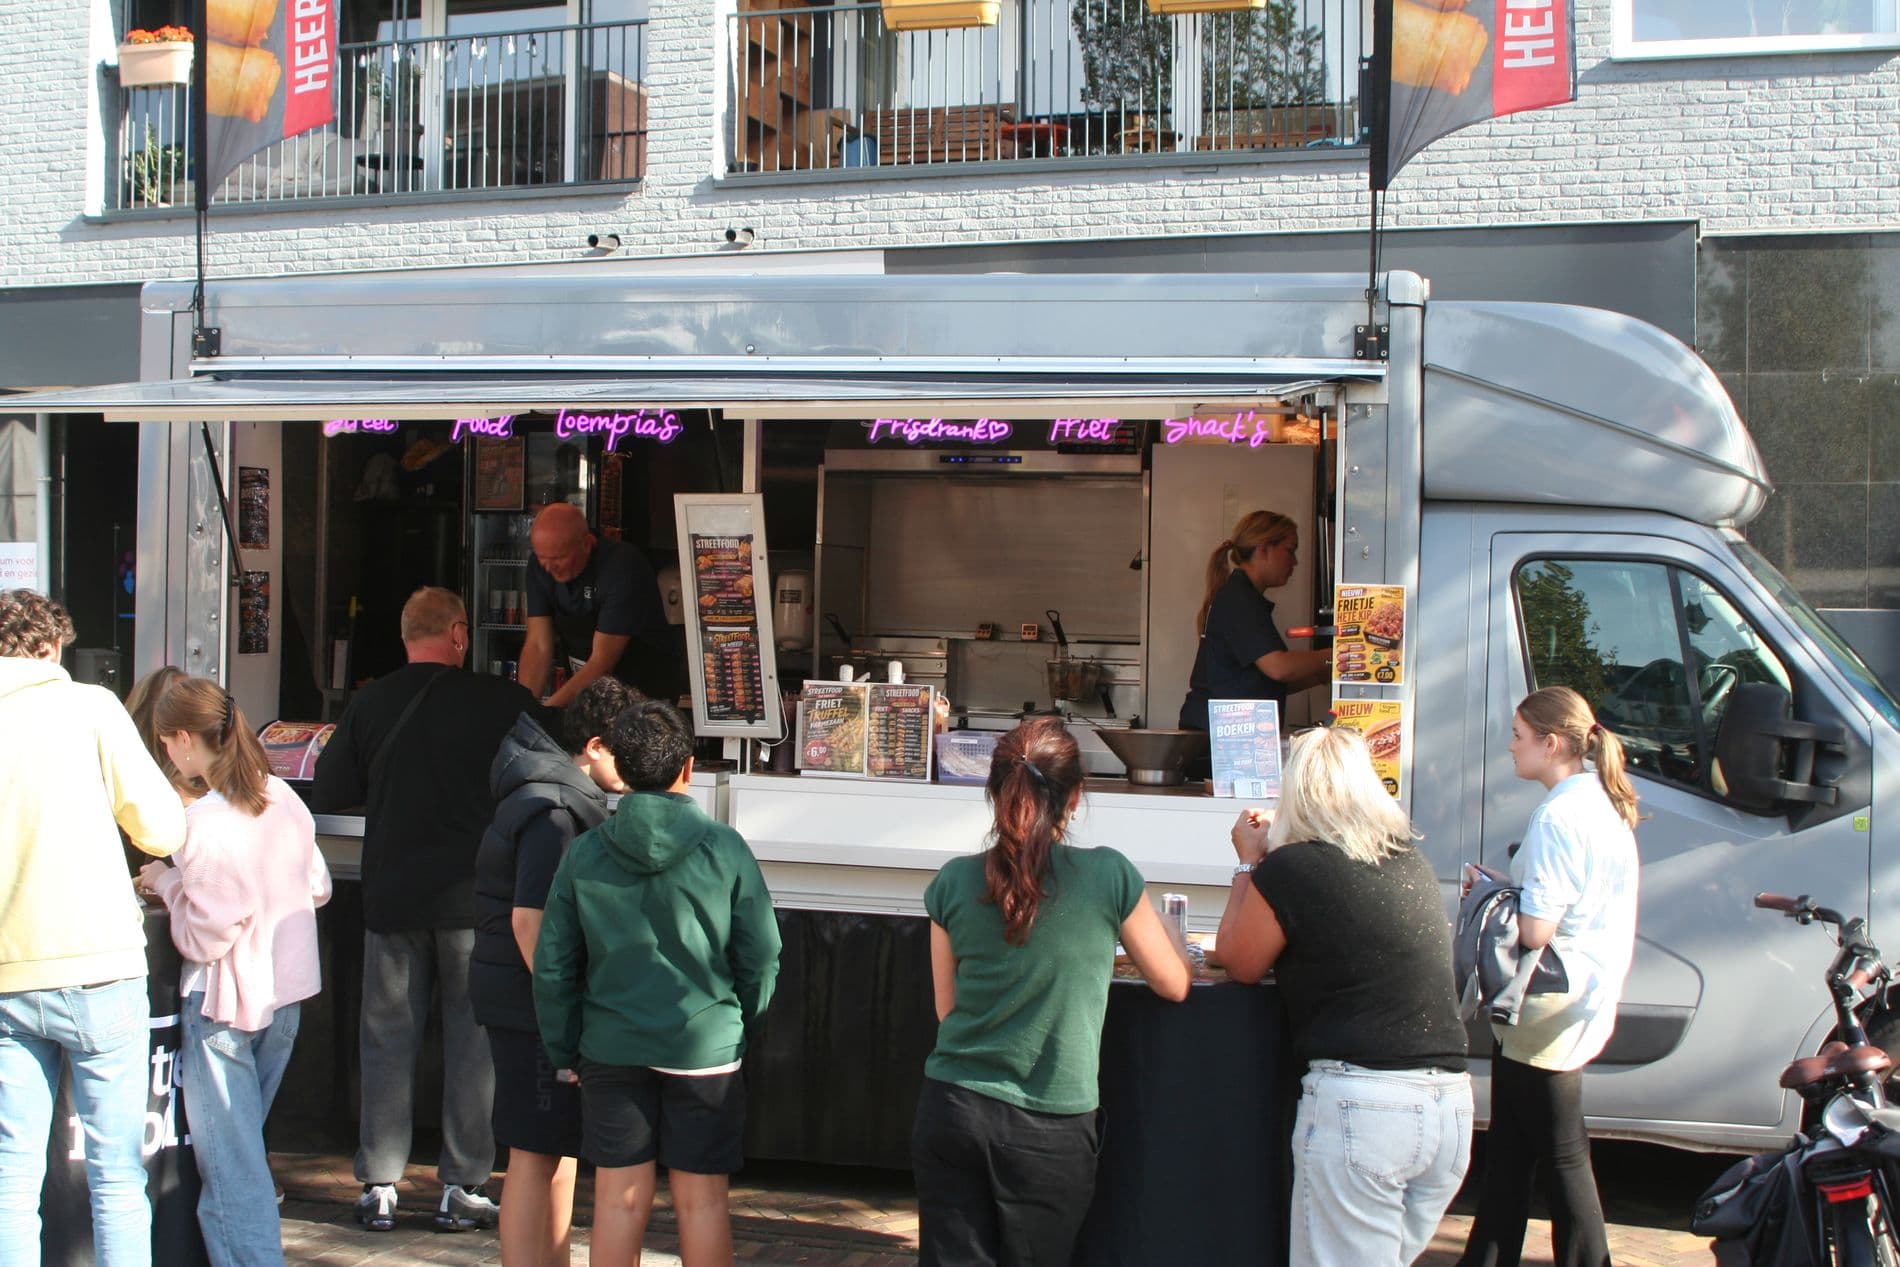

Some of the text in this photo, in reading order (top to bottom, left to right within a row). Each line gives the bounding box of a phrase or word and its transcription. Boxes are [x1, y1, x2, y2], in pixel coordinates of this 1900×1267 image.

[1503, 0, 1554, 68] HE
[1337, 597, 1375, 612] FRIETJE
[1337, 611, 1356, 623] HETE
[815, 698, 843, 710] FRIET
[1338, 703, 1374, 717] NIEUW
[807, 707, 850, 721] TRUFFEL
[1217, 723, 1255, 737] BOEKEN
